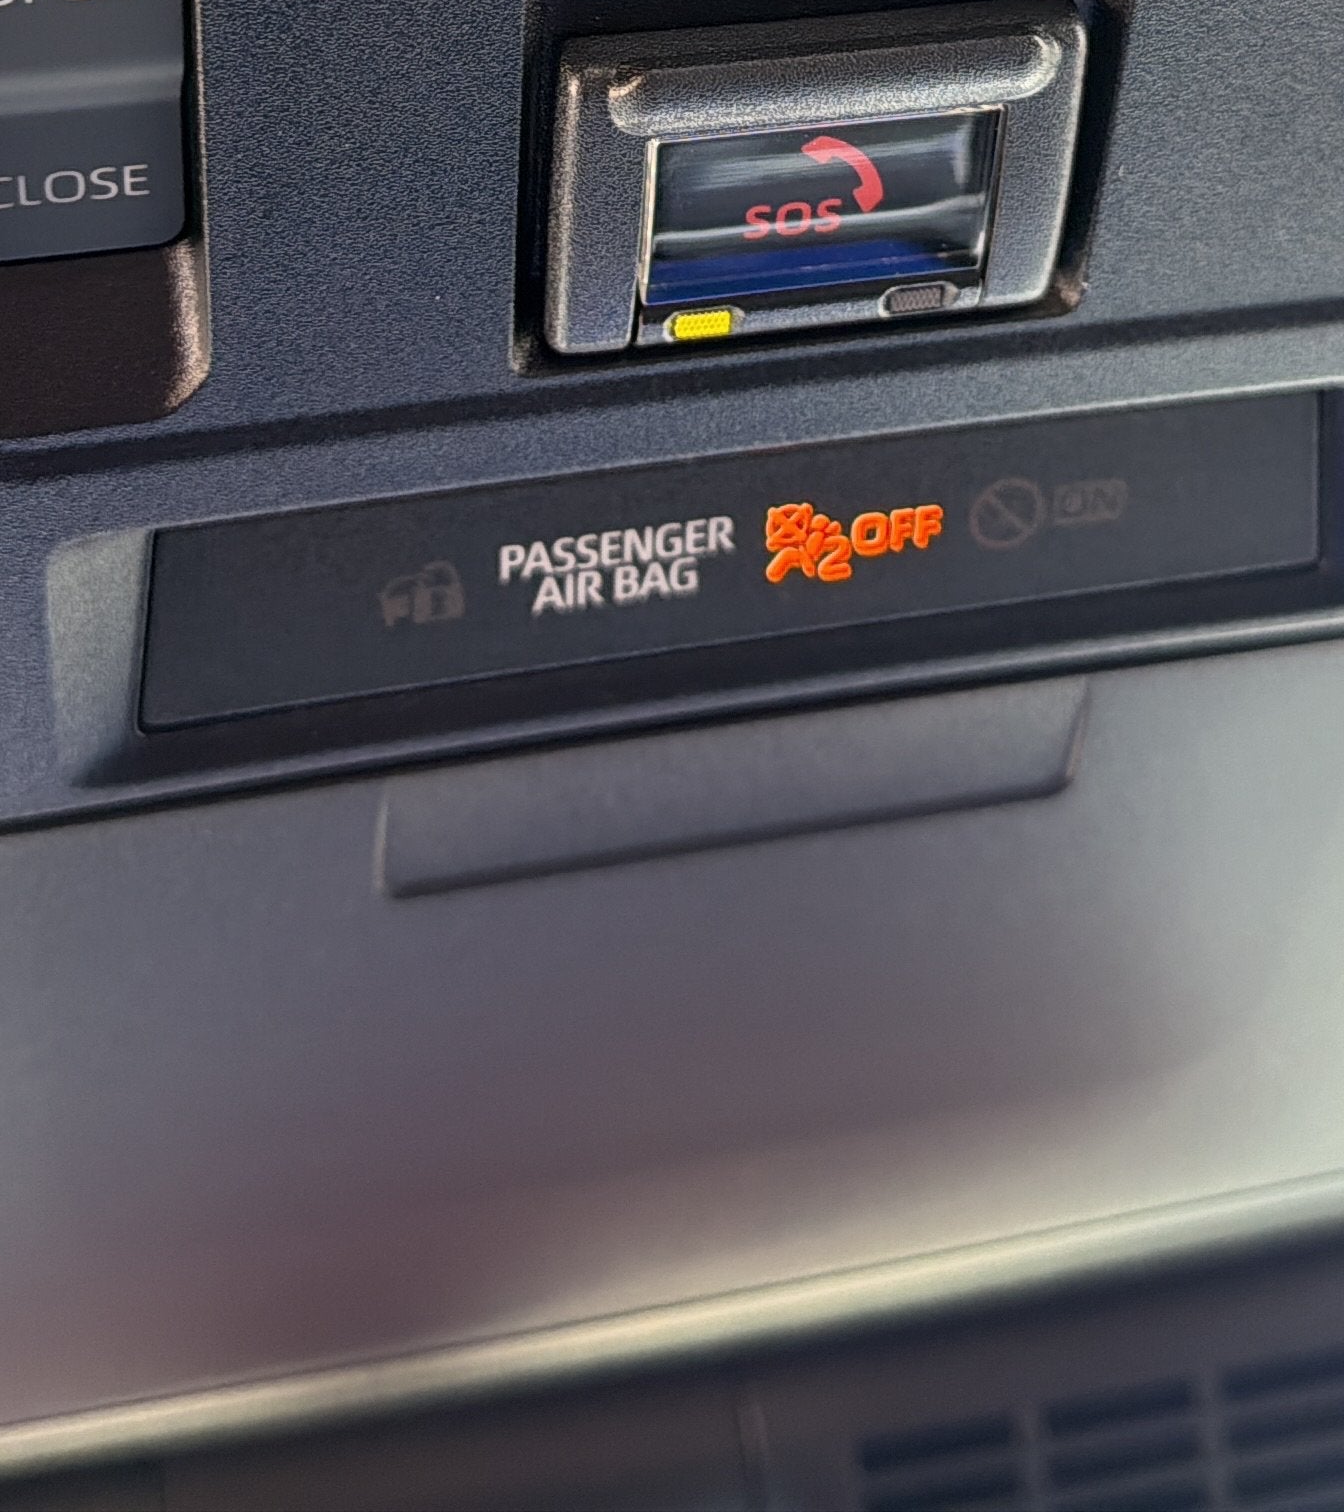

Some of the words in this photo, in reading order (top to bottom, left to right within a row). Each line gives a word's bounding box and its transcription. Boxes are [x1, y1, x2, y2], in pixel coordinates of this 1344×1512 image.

[743, 198, 843, 240] SOS
[498, 515, 736, 585] PASSENGER
[852, 504, 944, 557] OFF
[531, 570, 604, 616] AIR
[612, 556, 701, 604] BAG
